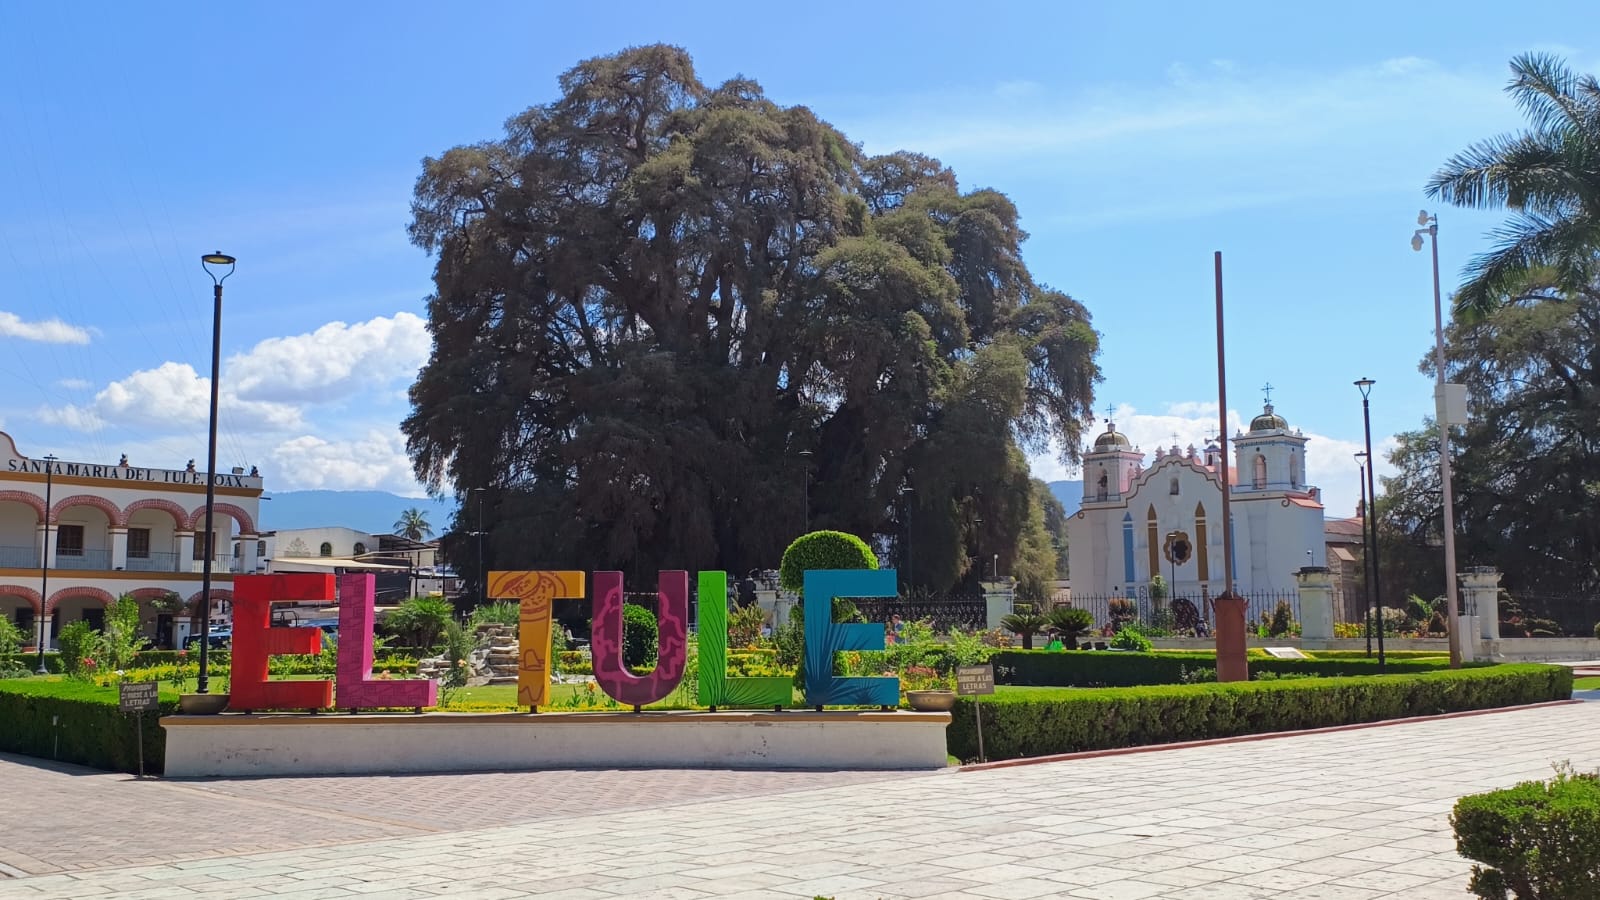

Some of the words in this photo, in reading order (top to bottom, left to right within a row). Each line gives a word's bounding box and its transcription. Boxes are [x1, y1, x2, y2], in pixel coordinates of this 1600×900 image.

[8, 459, 62, 475] SANTA
[66, 463, 119, 479] MARIA
[125, 468, 155, 481] DEL
[161, 471, 204, 485] TULE.
[214, 475, 248, 488] OAX.
[230, 573, 437, 709] EL
[487, 570, 899, 706] TULE
